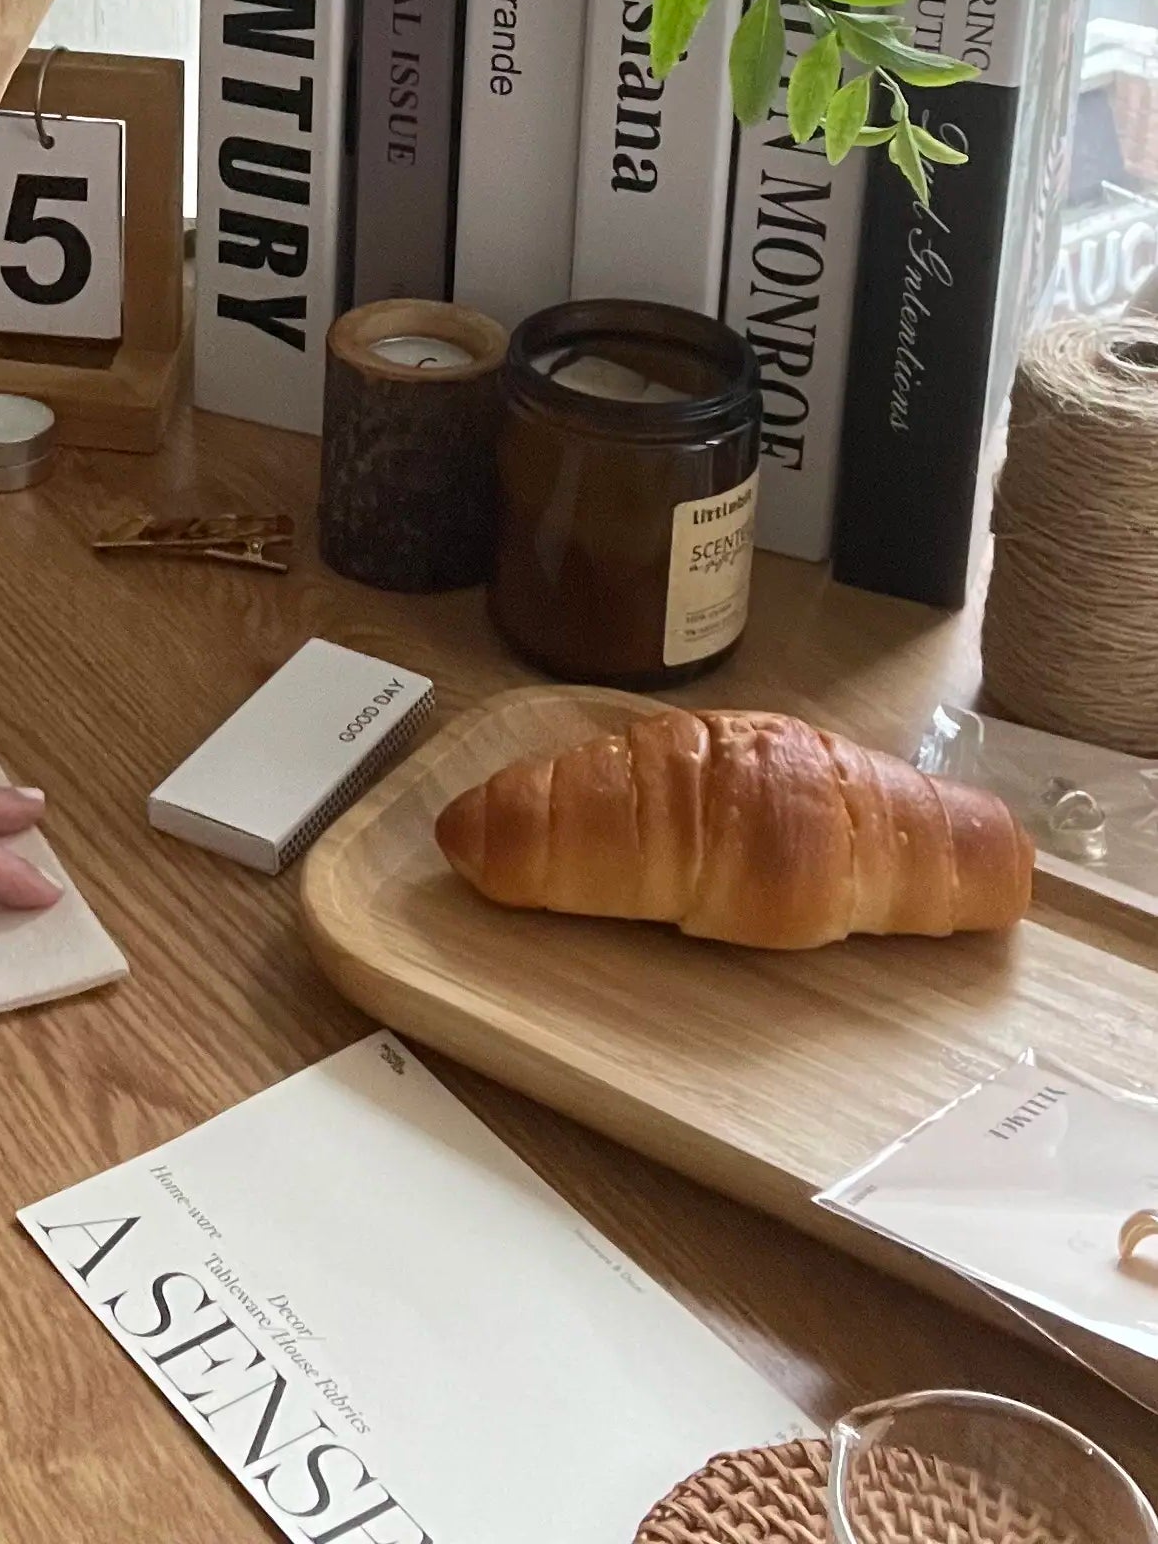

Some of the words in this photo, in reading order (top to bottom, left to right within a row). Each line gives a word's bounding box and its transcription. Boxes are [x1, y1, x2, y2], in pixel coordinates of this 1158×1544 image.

[387, 52, 420, 167] ISSUE
[0, 173, 92, 305] 5
[339, 706, 380, 743] GOOD
[373, 678, 405, 706] DAY
[150, 1165, 222, 1240] Home-ware
[37, 1216, 141, 1287] A
[315, 1378, 371, 1435] Fabrics
